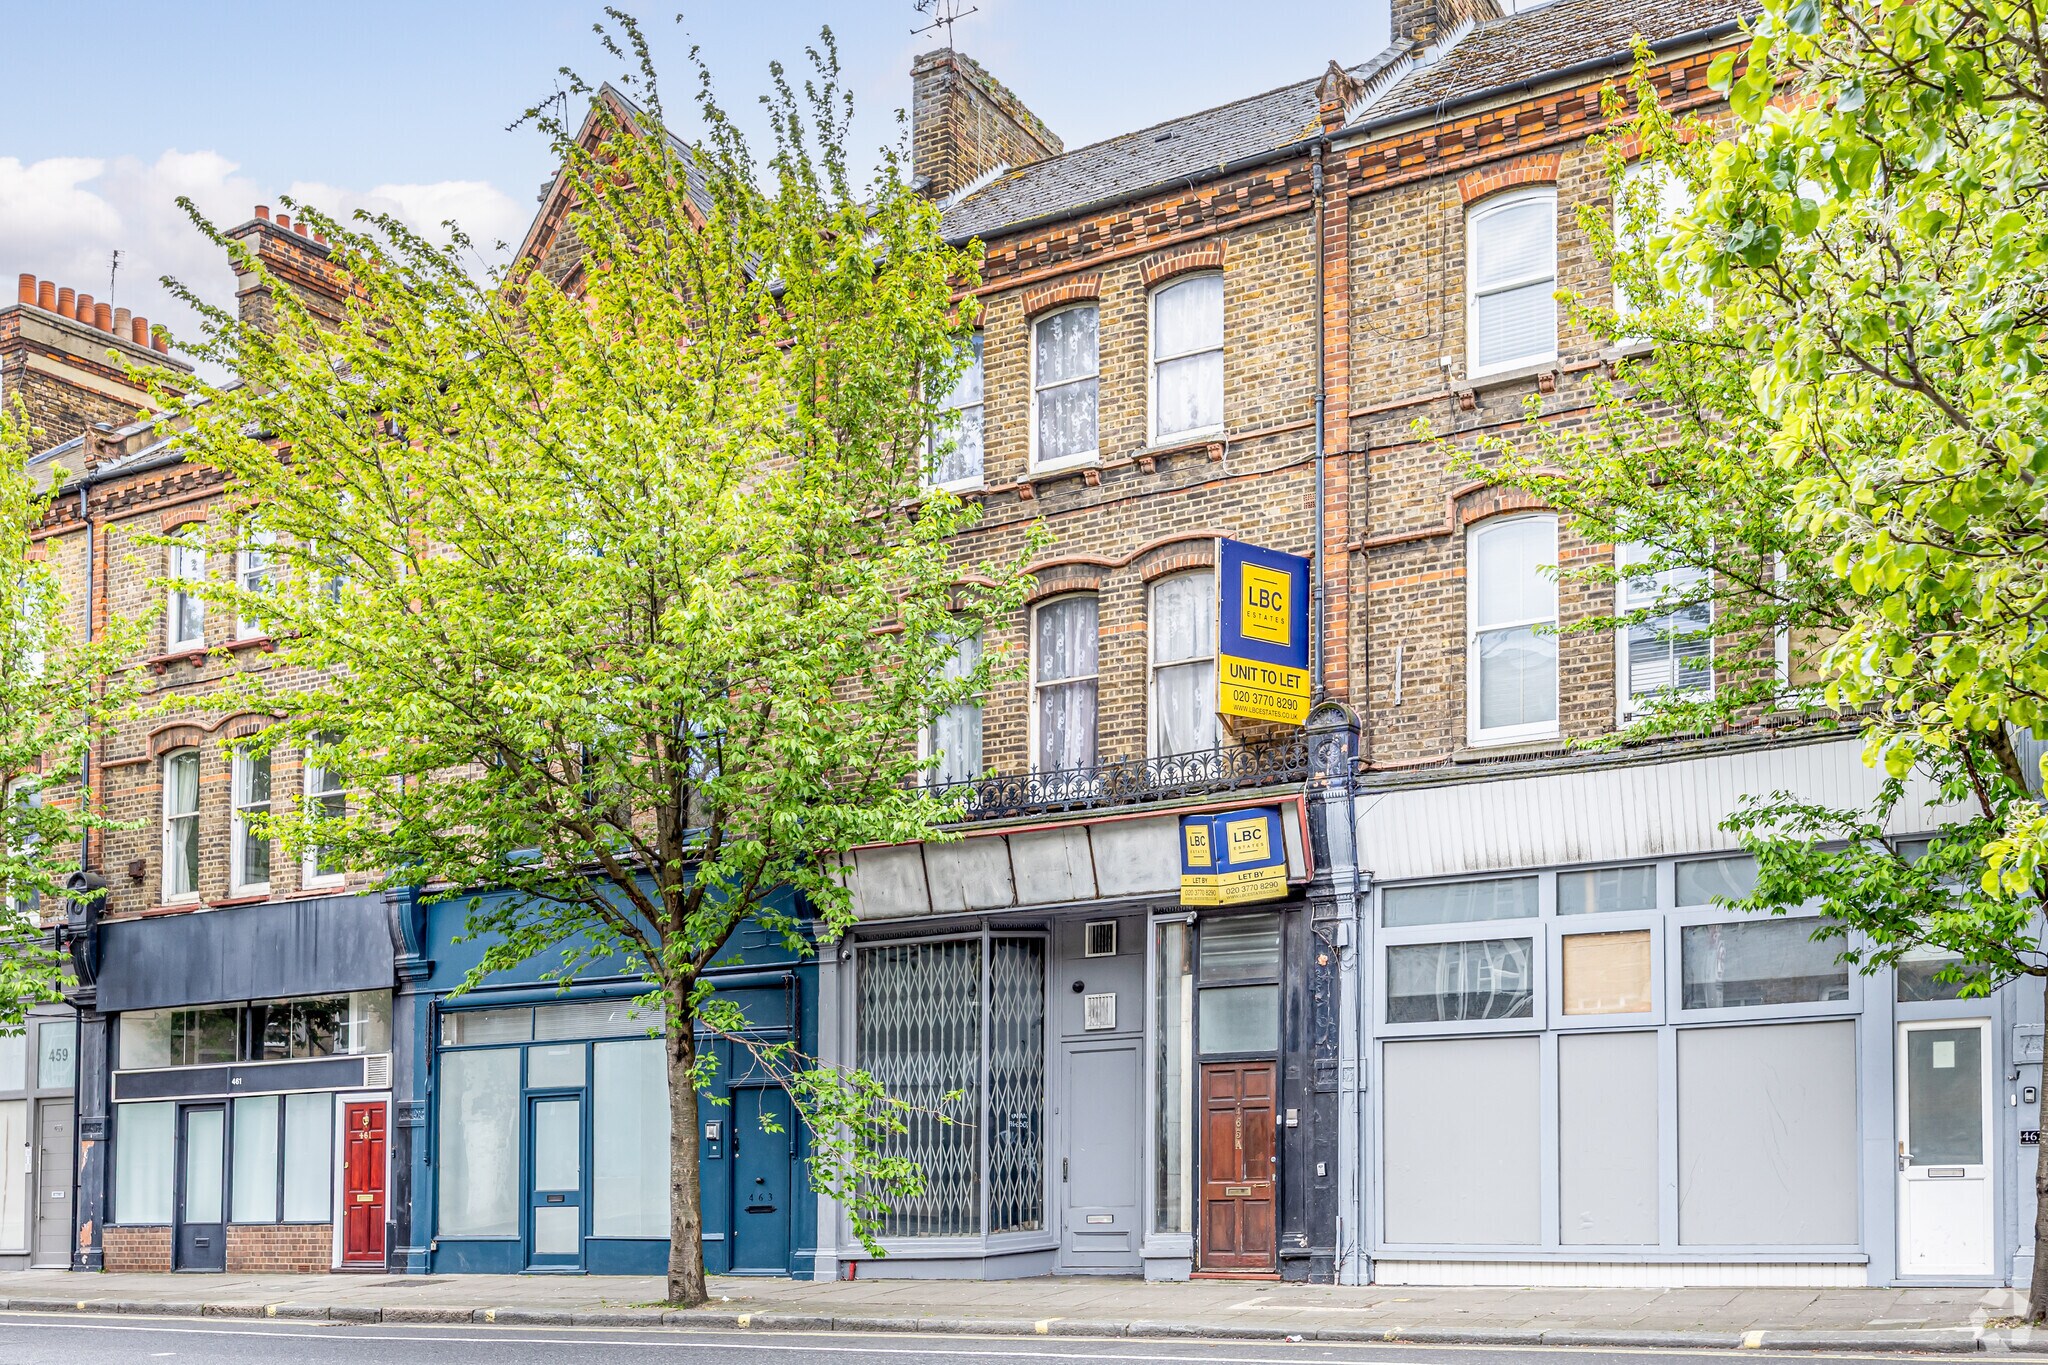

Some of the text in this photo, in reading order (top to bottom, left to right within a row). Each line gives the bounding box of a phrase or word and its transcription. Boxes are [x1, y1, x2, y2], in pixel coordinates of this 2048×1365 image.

[1249, 586, 1282, 612] LBC
[1247, 611, 1285, 625] ESTATES
[1230, 663, 1301, 689] UNIT TO LET
[1233, 689, 1298, 711] 020 3770 8290
[1233, 704, 1298, 720] WWW.LBCESTATES.CO.UK
[1190, 835, 1206, 847] LBC
[1234, 828, 1262, 843] LBC
[1233, 842, 1264, 851] ESTATES
[1238, 871, 1264, 881] LET BY
[1184, 889, 1194, 897] 020
[1226, 881, 1279, 895] 020 3770 8290
[48, 1047, 69, 1062] 459
[231, 1077, 242, 1085] 461
[359, 1131, 372, 1140] 461
[748, 1192, 773, 1201] 463
